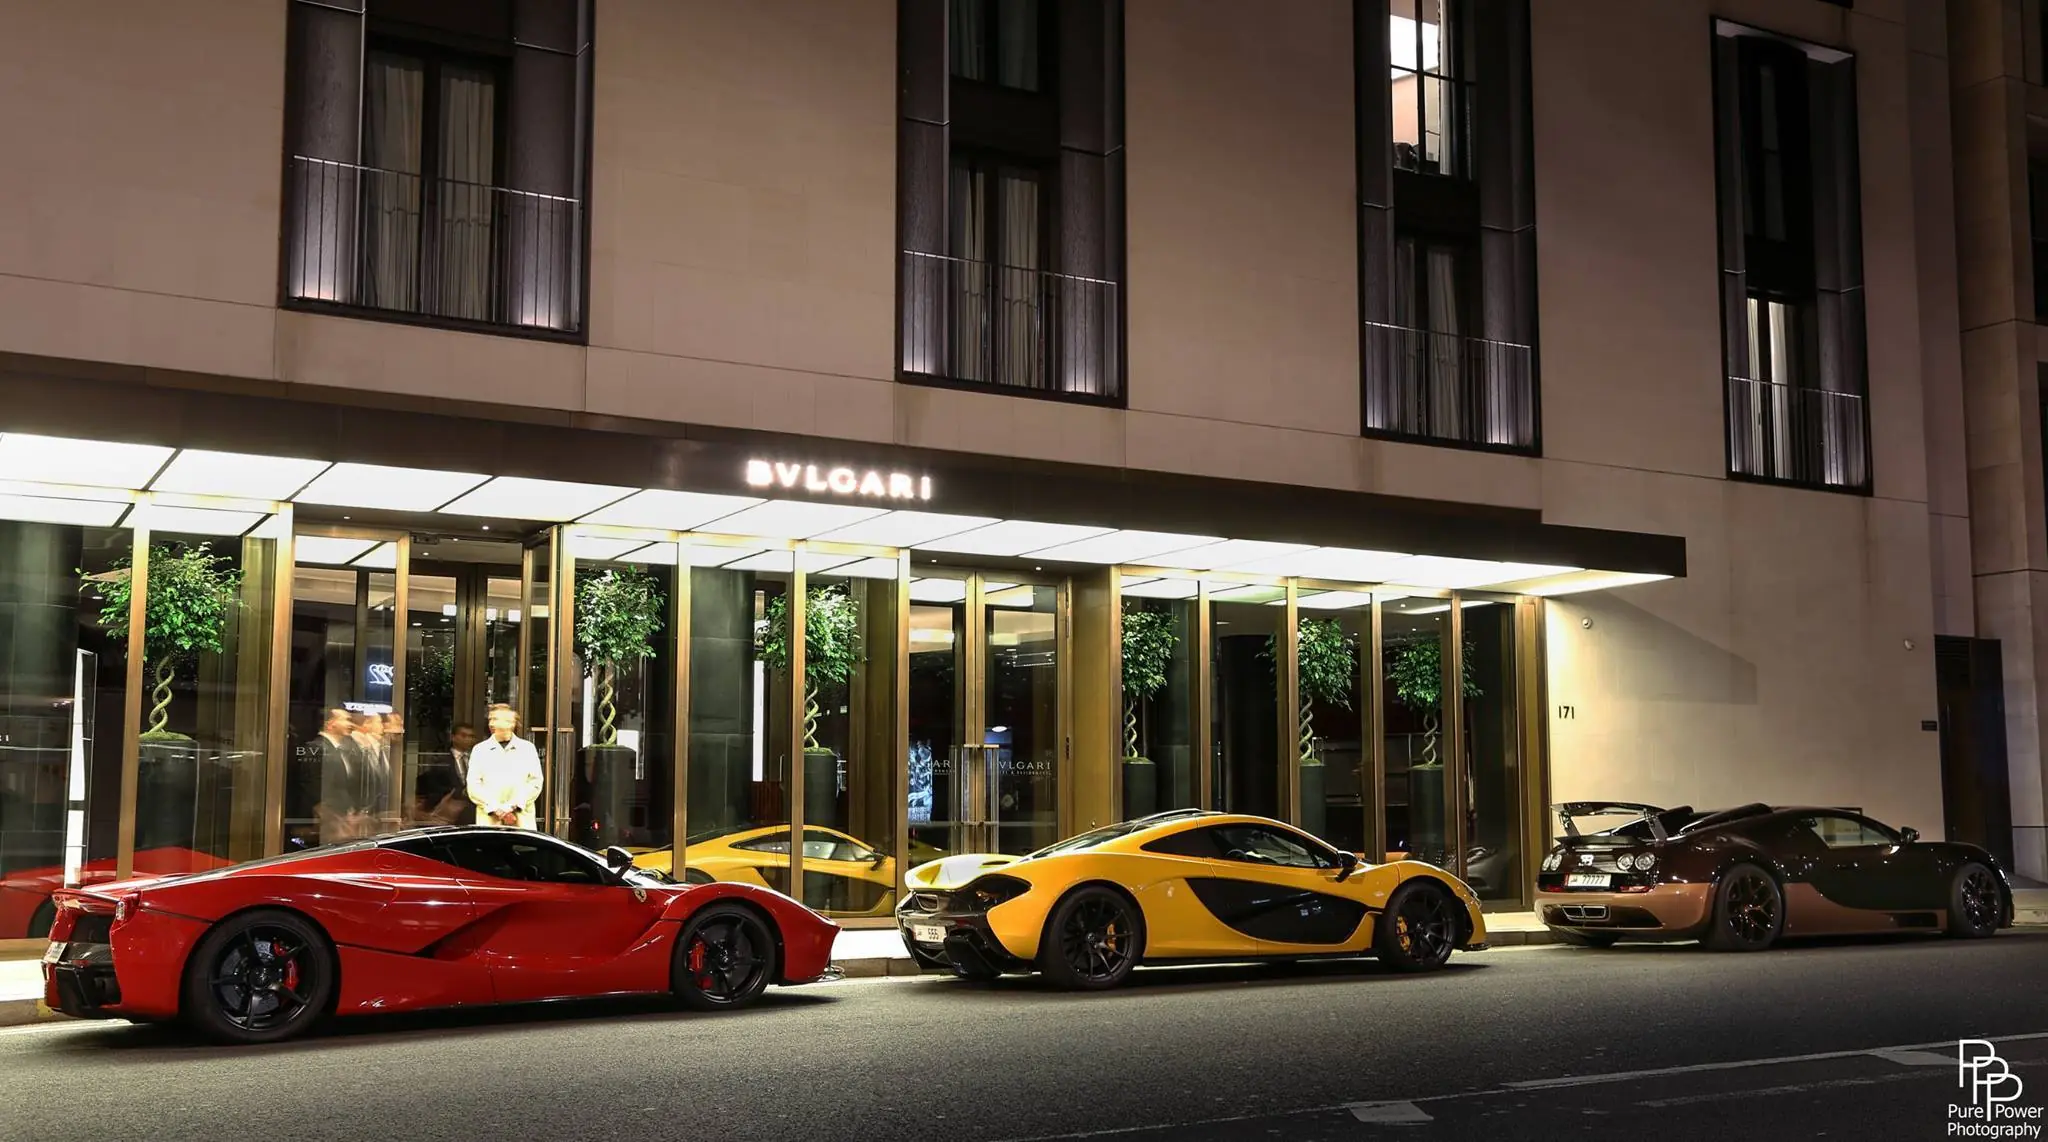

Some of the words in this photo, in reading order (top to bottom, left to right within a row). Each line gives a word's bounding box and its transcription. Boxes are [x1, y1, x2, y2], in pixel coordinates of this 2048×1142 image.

[747, 460, 931, 500] BVLGARI
[1558, 705, 1575, 720] 171
[998, 761, 1050, 770] VLGARI
